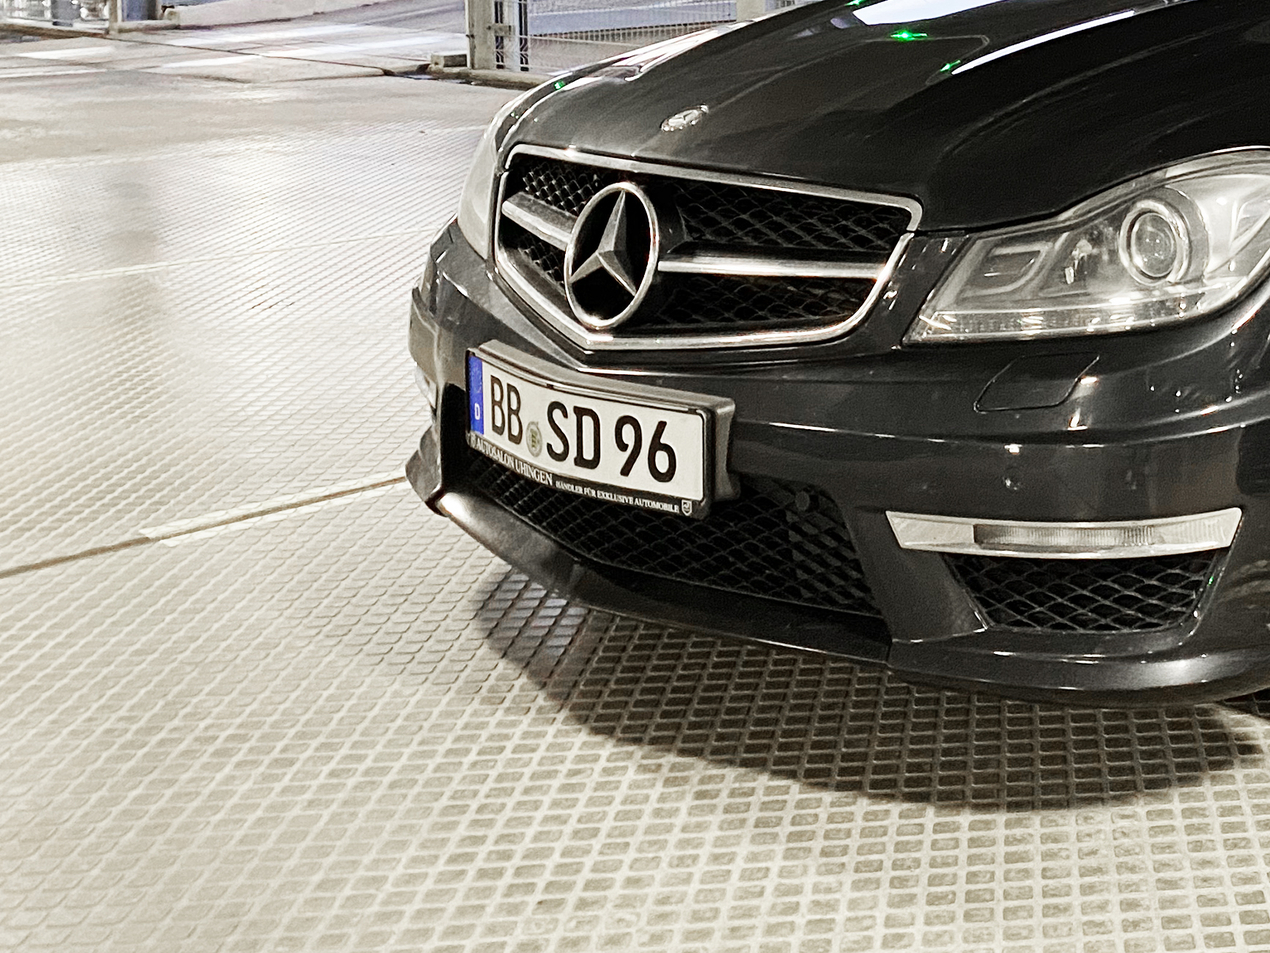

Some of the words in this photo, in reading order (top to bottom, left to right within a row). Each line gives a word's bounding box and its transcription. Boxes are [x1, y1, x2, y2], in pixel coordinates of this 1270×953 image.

[474, 402, 481, 421] D
[490, 374, 524, 445] BB
[546, 401, 601, 470] SD
[614, 415, 677, 483] 96
[475, 437, 515, 469] AUTOSALON
[515, 458, 553, 486] UHINGEN
[583, 486, 597, 498] FÜR
[596, 489, 634, 505] EXKLUSIVE
[634, 497, 680, 514] AUTOMOBILE
